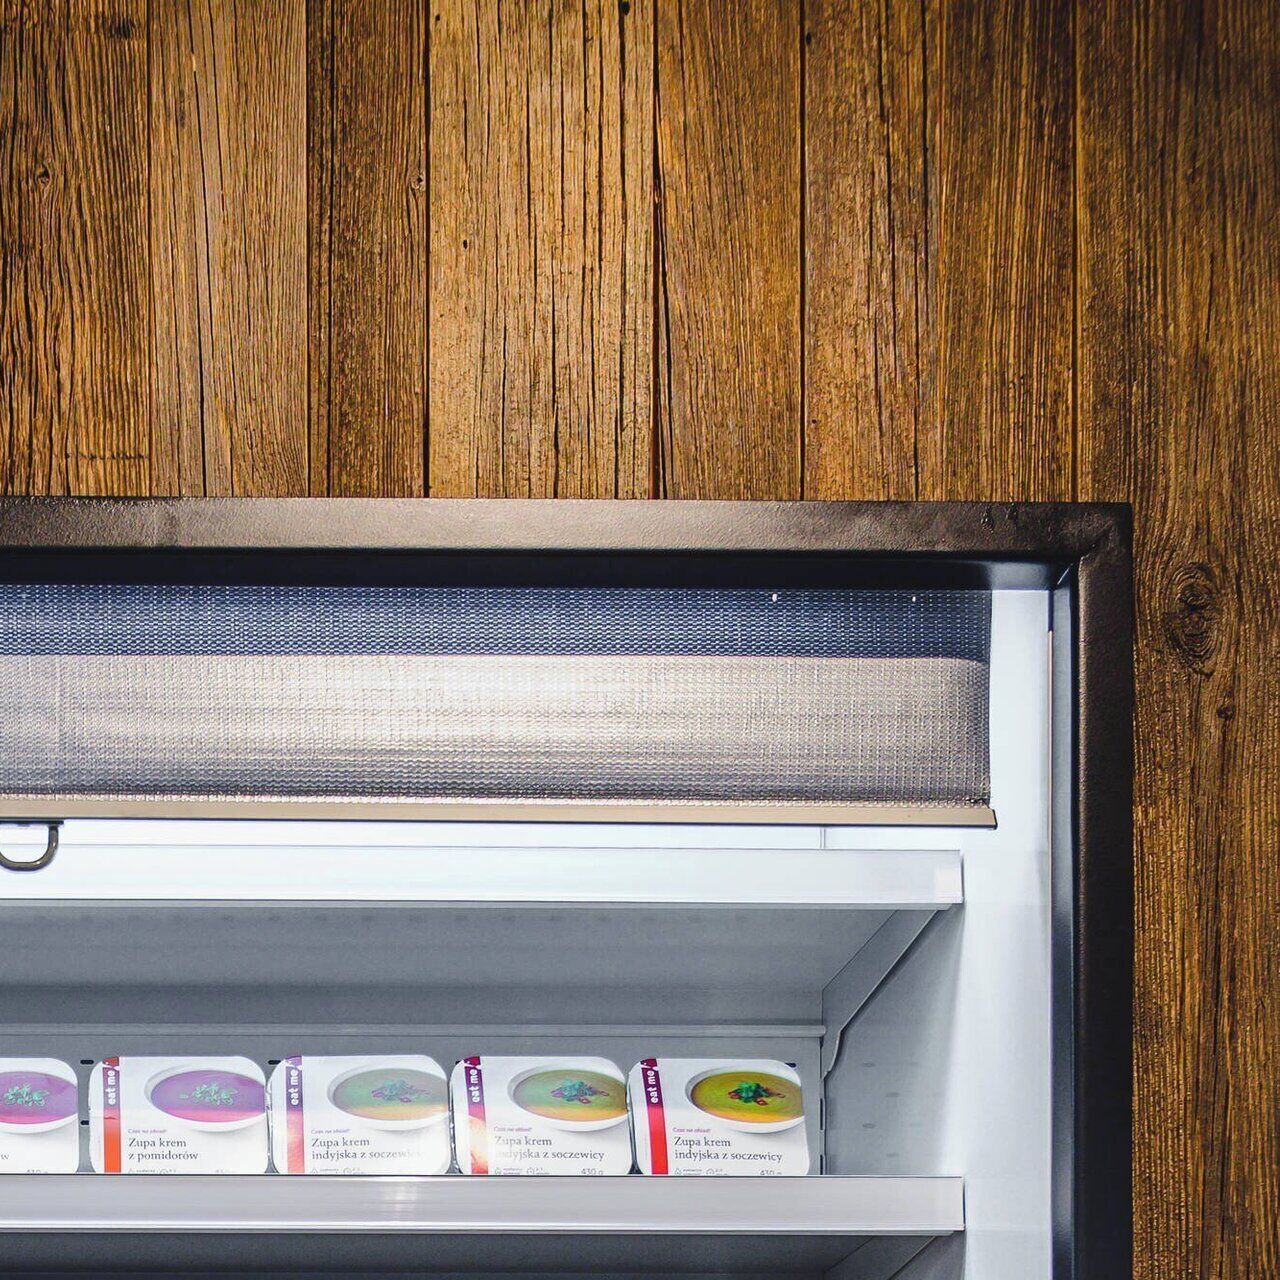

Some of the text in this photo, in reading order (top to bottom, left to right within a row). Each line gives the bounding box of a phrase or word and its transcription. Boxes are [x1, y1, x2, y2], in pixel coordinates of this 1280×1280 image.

[105, 1070, 115, 1105] eat me
[288, 1069, 298, 1106] eat me
[469, 1068, 480, 1103] eat me
[647, 1070, 658, 1104] eat me
[128, 1137, 187, 1150] Zupa krem
[312, 1137, 370, 1150] Zupa krem
[524, 1136, 552, 1146] krem
[674, 1136, 731, 1148] Zupa krem
[137, 1150, 198, 1162] pomidorów
[312, 1149, 357, 1162] indyjska
[548, 1150, 604, 1162] soczewicy
[675, 1149, 720, 1161] indyjska
[730, 1151, 783, 1163] soczewicy
